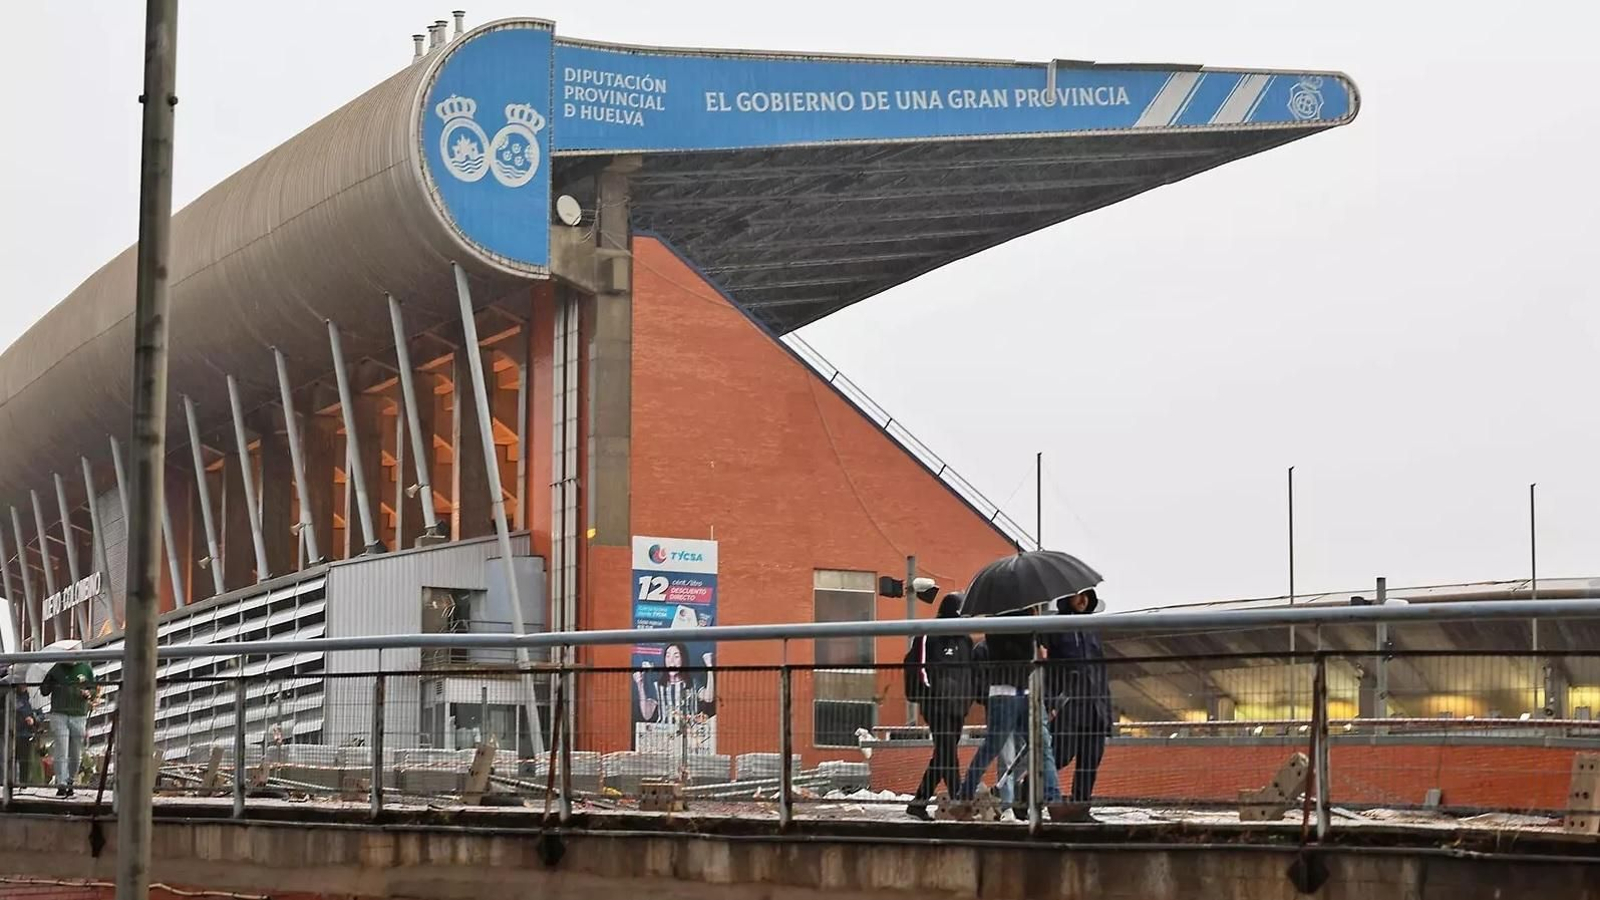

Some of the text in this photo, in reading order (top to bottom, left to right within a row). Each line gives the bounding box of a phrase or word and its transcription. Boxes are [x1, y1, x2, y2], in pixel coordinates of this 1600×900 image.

[564, 67, 666, 94] DIPUTACIÓN
[564, 85, 665, 111] PROVINCIAL
[705, 86, 1131, 113] EL GOBIERNO DE UNA GRAN PROVINCIA
[581, 105, 645, 127] HUELVA
[638, 575, 669, 602] 12
[670, 587, 707, 595] DESCUENTO
